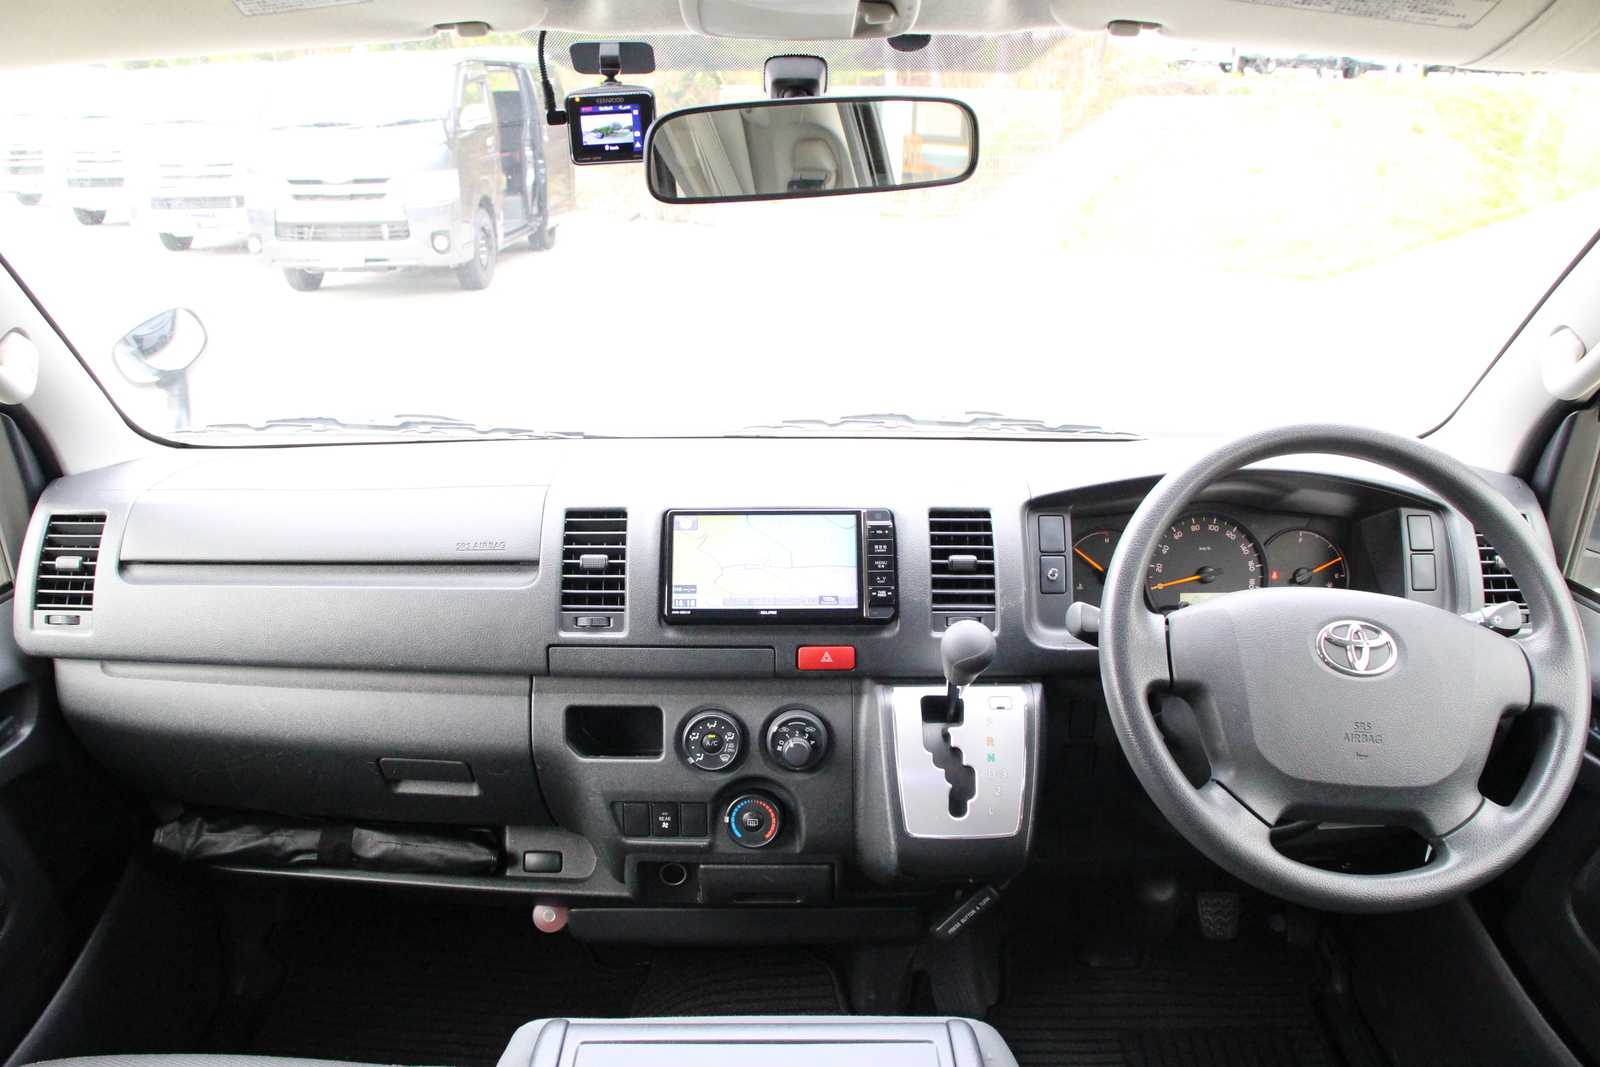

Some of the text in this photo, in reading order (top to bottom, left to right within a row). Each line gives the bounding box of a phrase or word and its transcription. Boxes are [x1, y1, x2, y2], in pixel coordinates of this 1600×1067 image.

[1190, 524, 1200, 532] 80
[1208, 524, 1219, 532] 100
[1173, 531, 1183, 540] 60
[1225, 530, 1236, 540] 120
[473, 541, 506, 549] AIRBAG
[1161, 545, 1170, 555] 40
[1240, 543, 1250, 555] 140
[1156, 563, 1163, 573] 20
[675, 599, 696, 607] 16:18
[985, 717, 993, 727] P
[1353, 722, 1372, 731] SRS
[986, 737, 995, 746] R
[1343, 733, 1383, 744] AIRBAG
[987, 753, 996, 762] N
[995, 786, 1002, 796] 2
[988, 805, 996, 815] L
[960, 909, 976, 924] BUTTON
